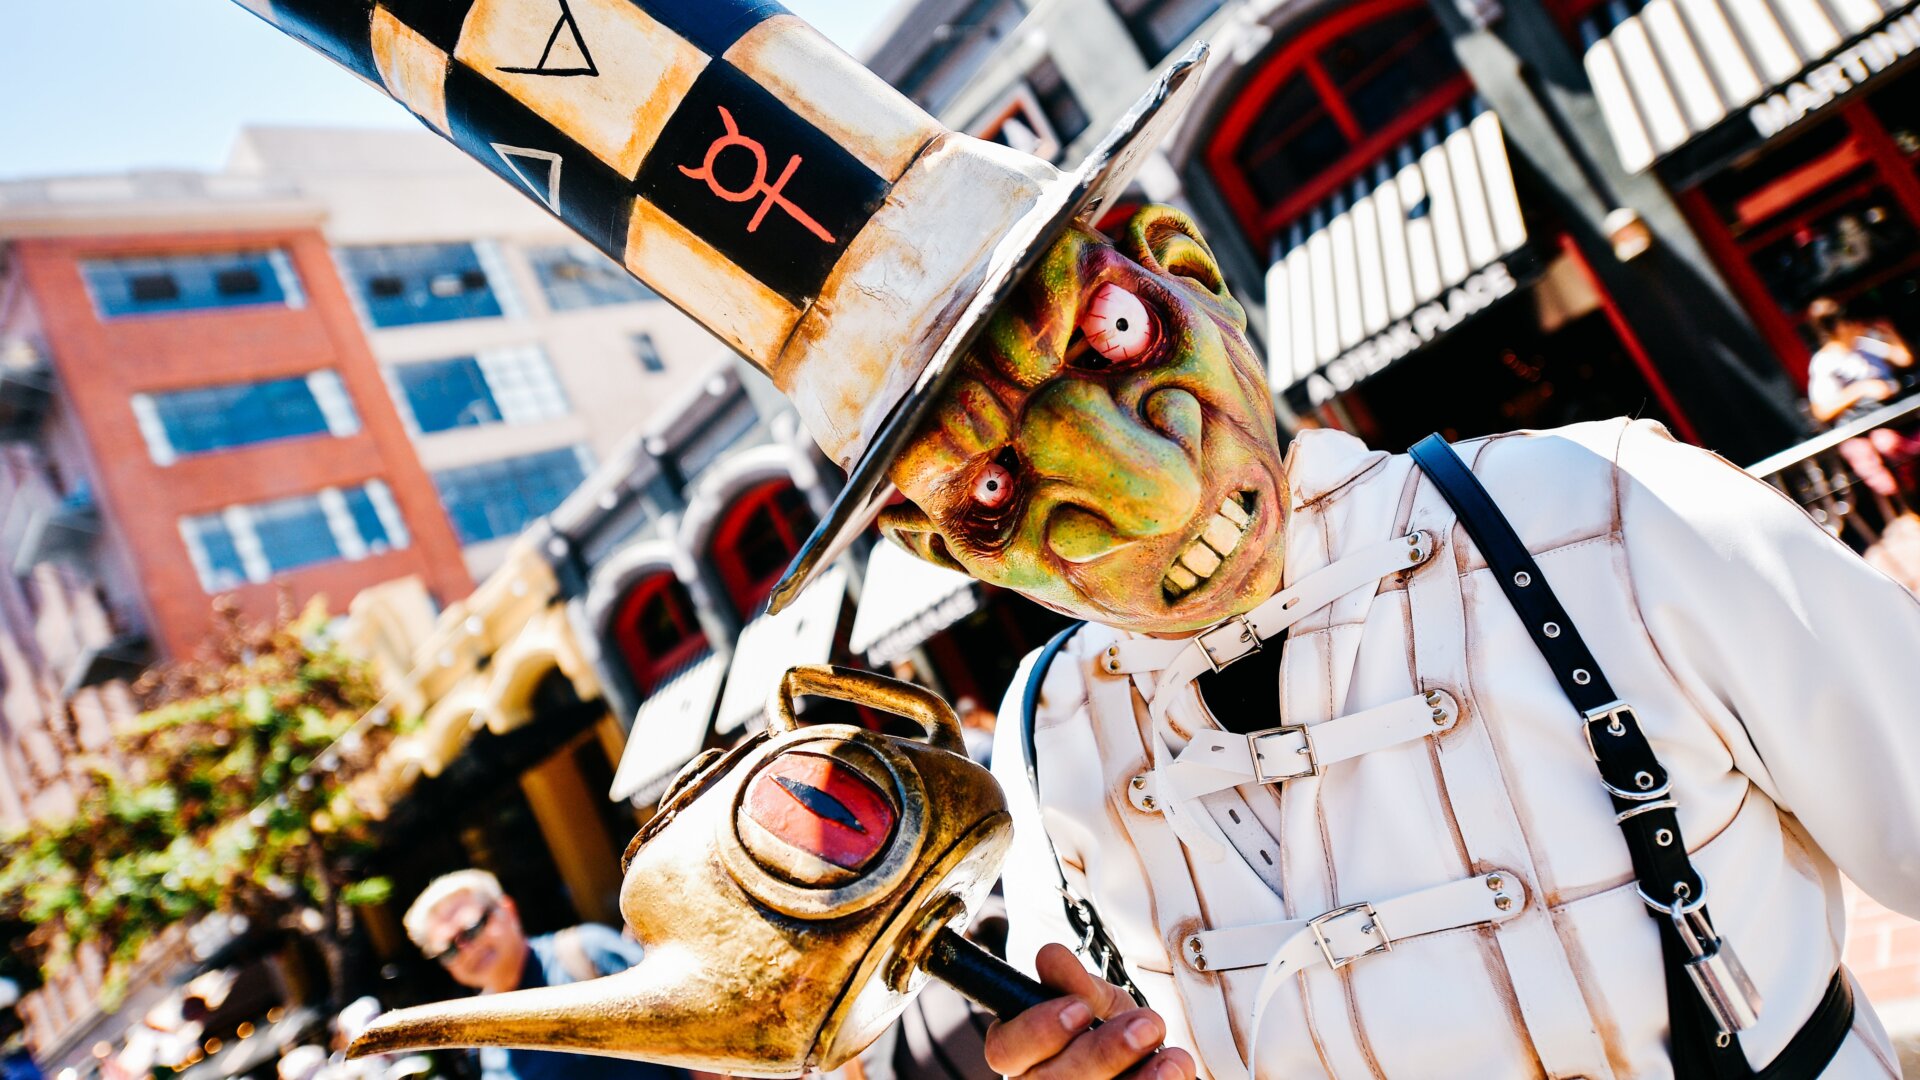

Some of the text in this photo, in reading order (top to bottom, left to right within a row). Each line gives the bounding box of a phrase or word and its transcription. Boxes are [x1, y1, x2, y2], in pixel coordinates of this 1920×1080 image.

[1749, 5, 1920, 138] MARTINI
[1307, 261, 1518, 406] A STEAK PLACE
